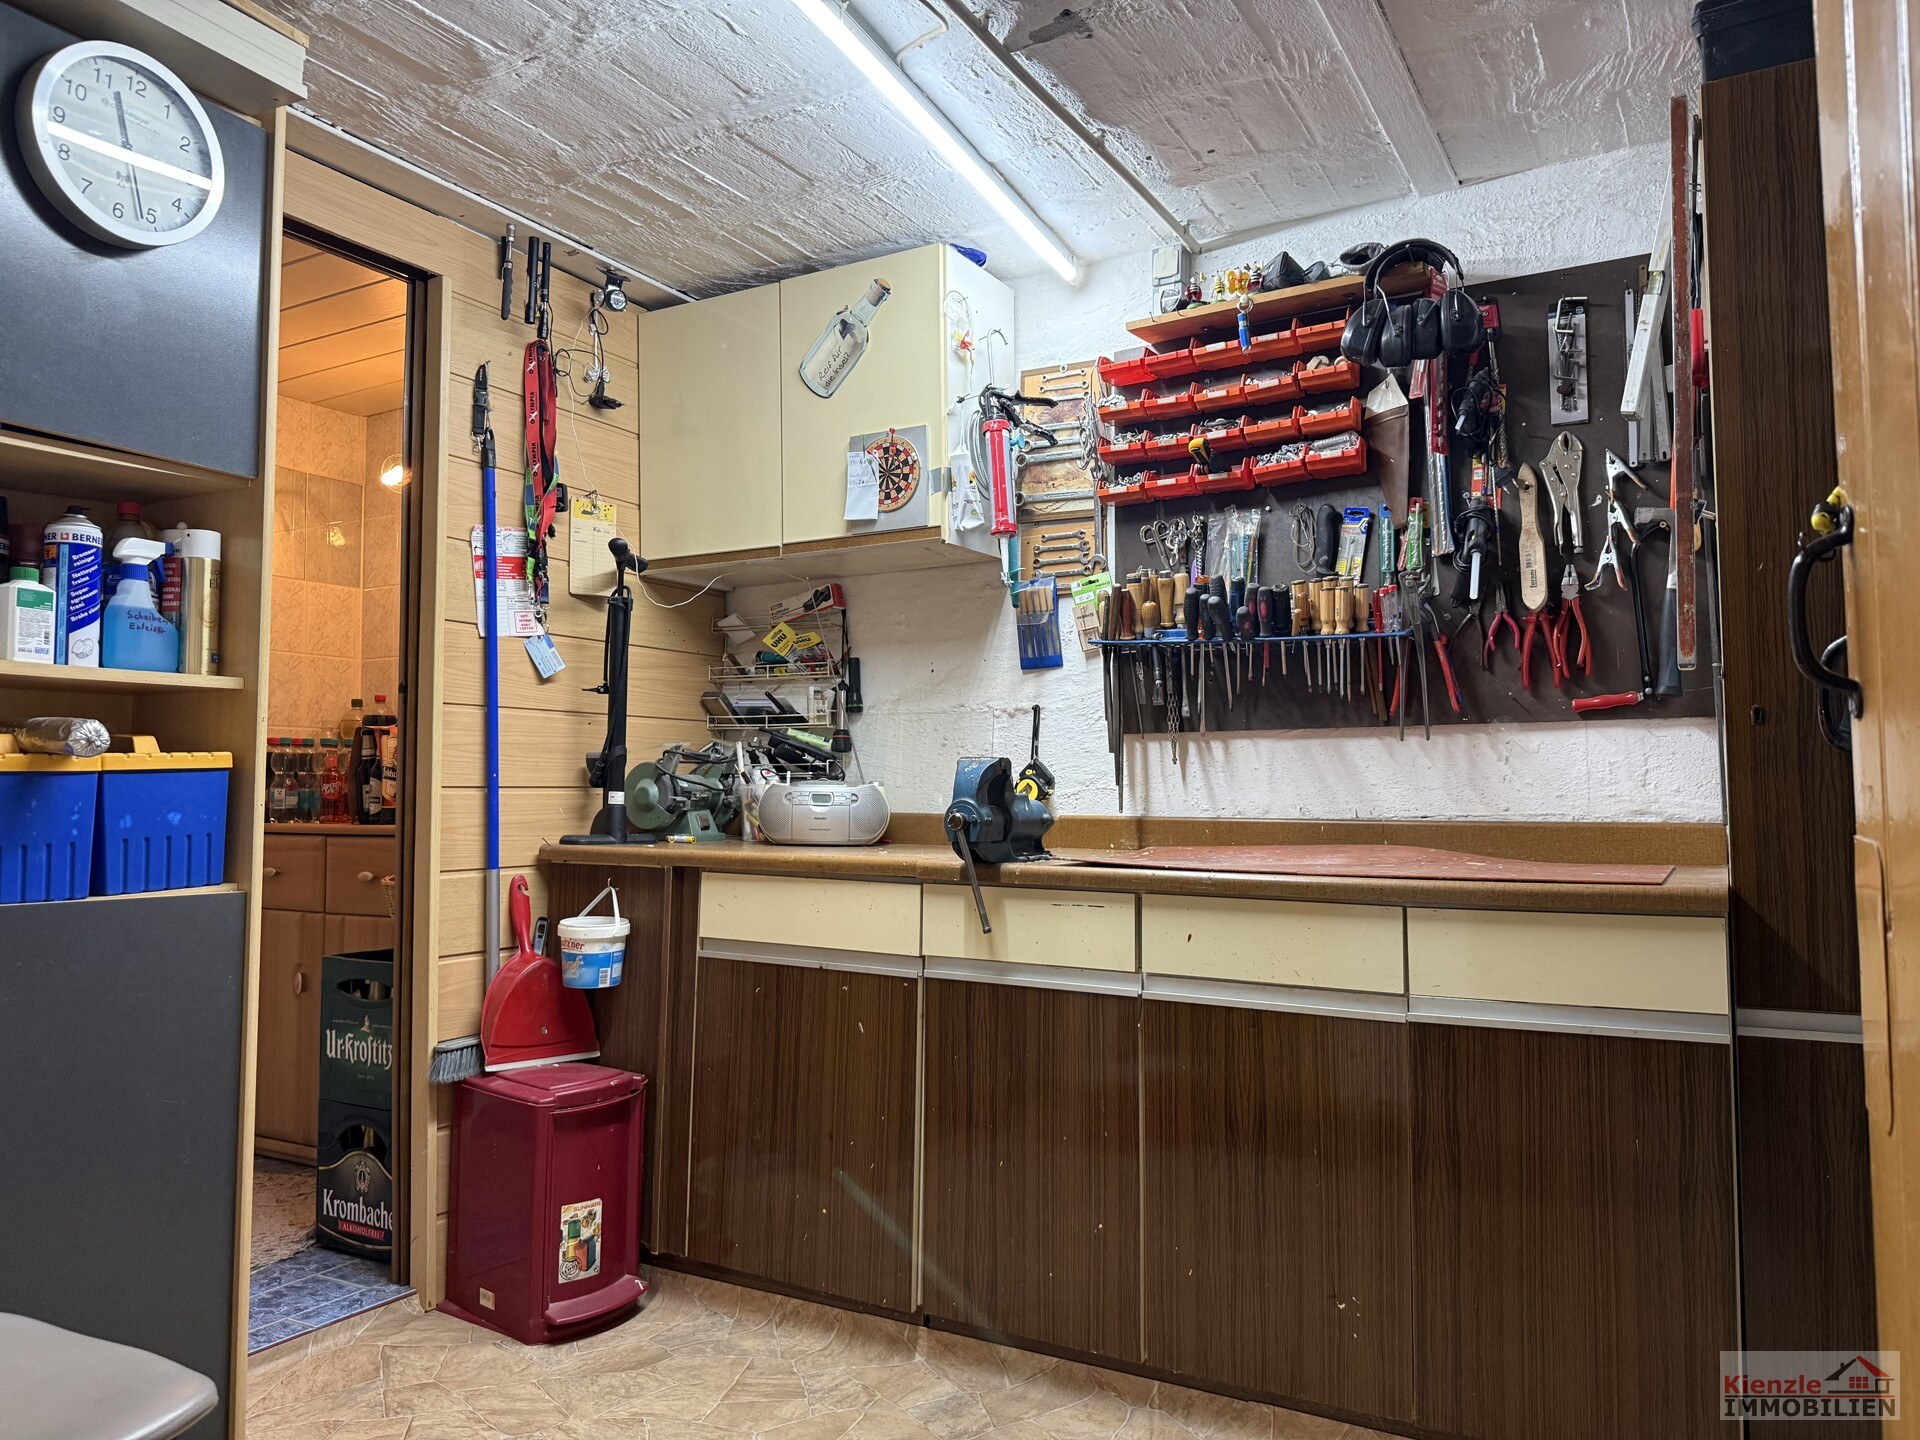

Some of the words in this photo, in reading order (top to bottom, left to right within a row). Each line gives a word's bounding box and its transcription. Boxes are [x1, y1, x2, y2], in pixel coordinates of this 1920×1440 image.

[93, 67, 113, 89] 11
[64, 79, 88, 101] 10
[126, 75, 148, 99] 12
[52, 105, 66, 123] 9
[163, 104, 171, 119] 1
[58, 143, 70, 161] 8
[179, 136, 191, 154] 2
[81, 177, 93, 195] 7
[112, 202, 124, 219] 6
[171, 197, 182, 212] 4
[145, 207, 157, 224] 5
[825, 375, 836, 387] die
[770, 633, 788, 648] UHU
[793, 637, 812, 645] UHU
[342, 1223, 381, 1239] ALKOHOLFREI
